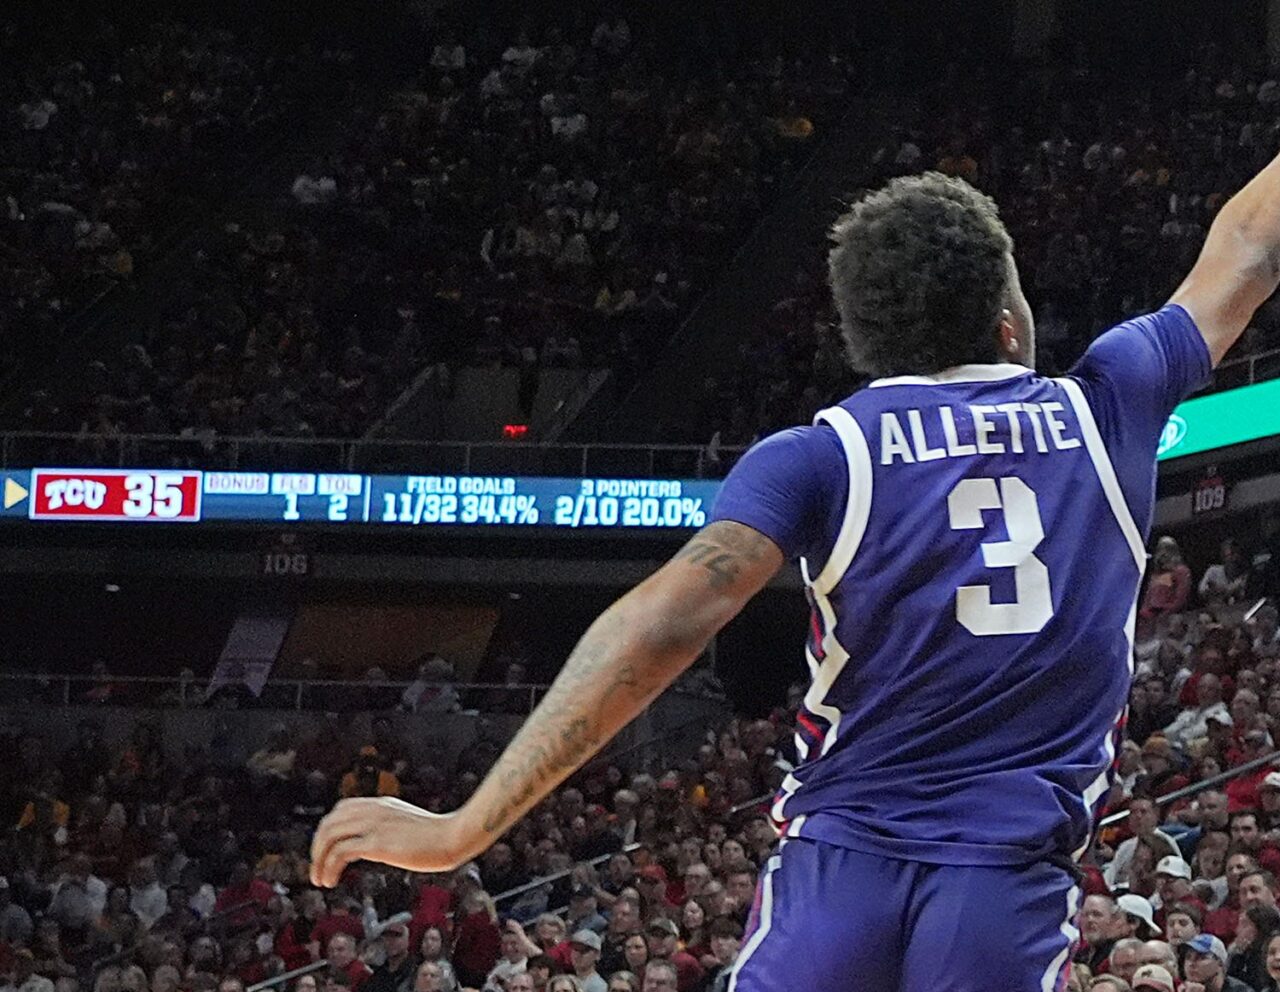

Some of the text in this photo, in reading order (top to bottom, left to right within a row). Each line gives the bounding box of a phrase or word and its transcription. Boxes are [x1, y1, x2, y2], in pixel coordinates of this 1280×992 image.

[880, 401, 1082, 466] ALLETTE
[44, 478, 107, 511] TCU
[122, 474, 184, 518] 35
[208, 473, 266, 491] BONUS
[406, 476, 516, 496] FIELD GOALS
[581, 479, 682, 498] 3 POINTERS
[282, 493, 300, 520] 1
[328, 493, 348, 520] 2
[383, 493, 539, 525] 11/32 34.4%
[554, 496, 706, 528] 2/10 20.0%
[947, 476, 1055, 636] 3
